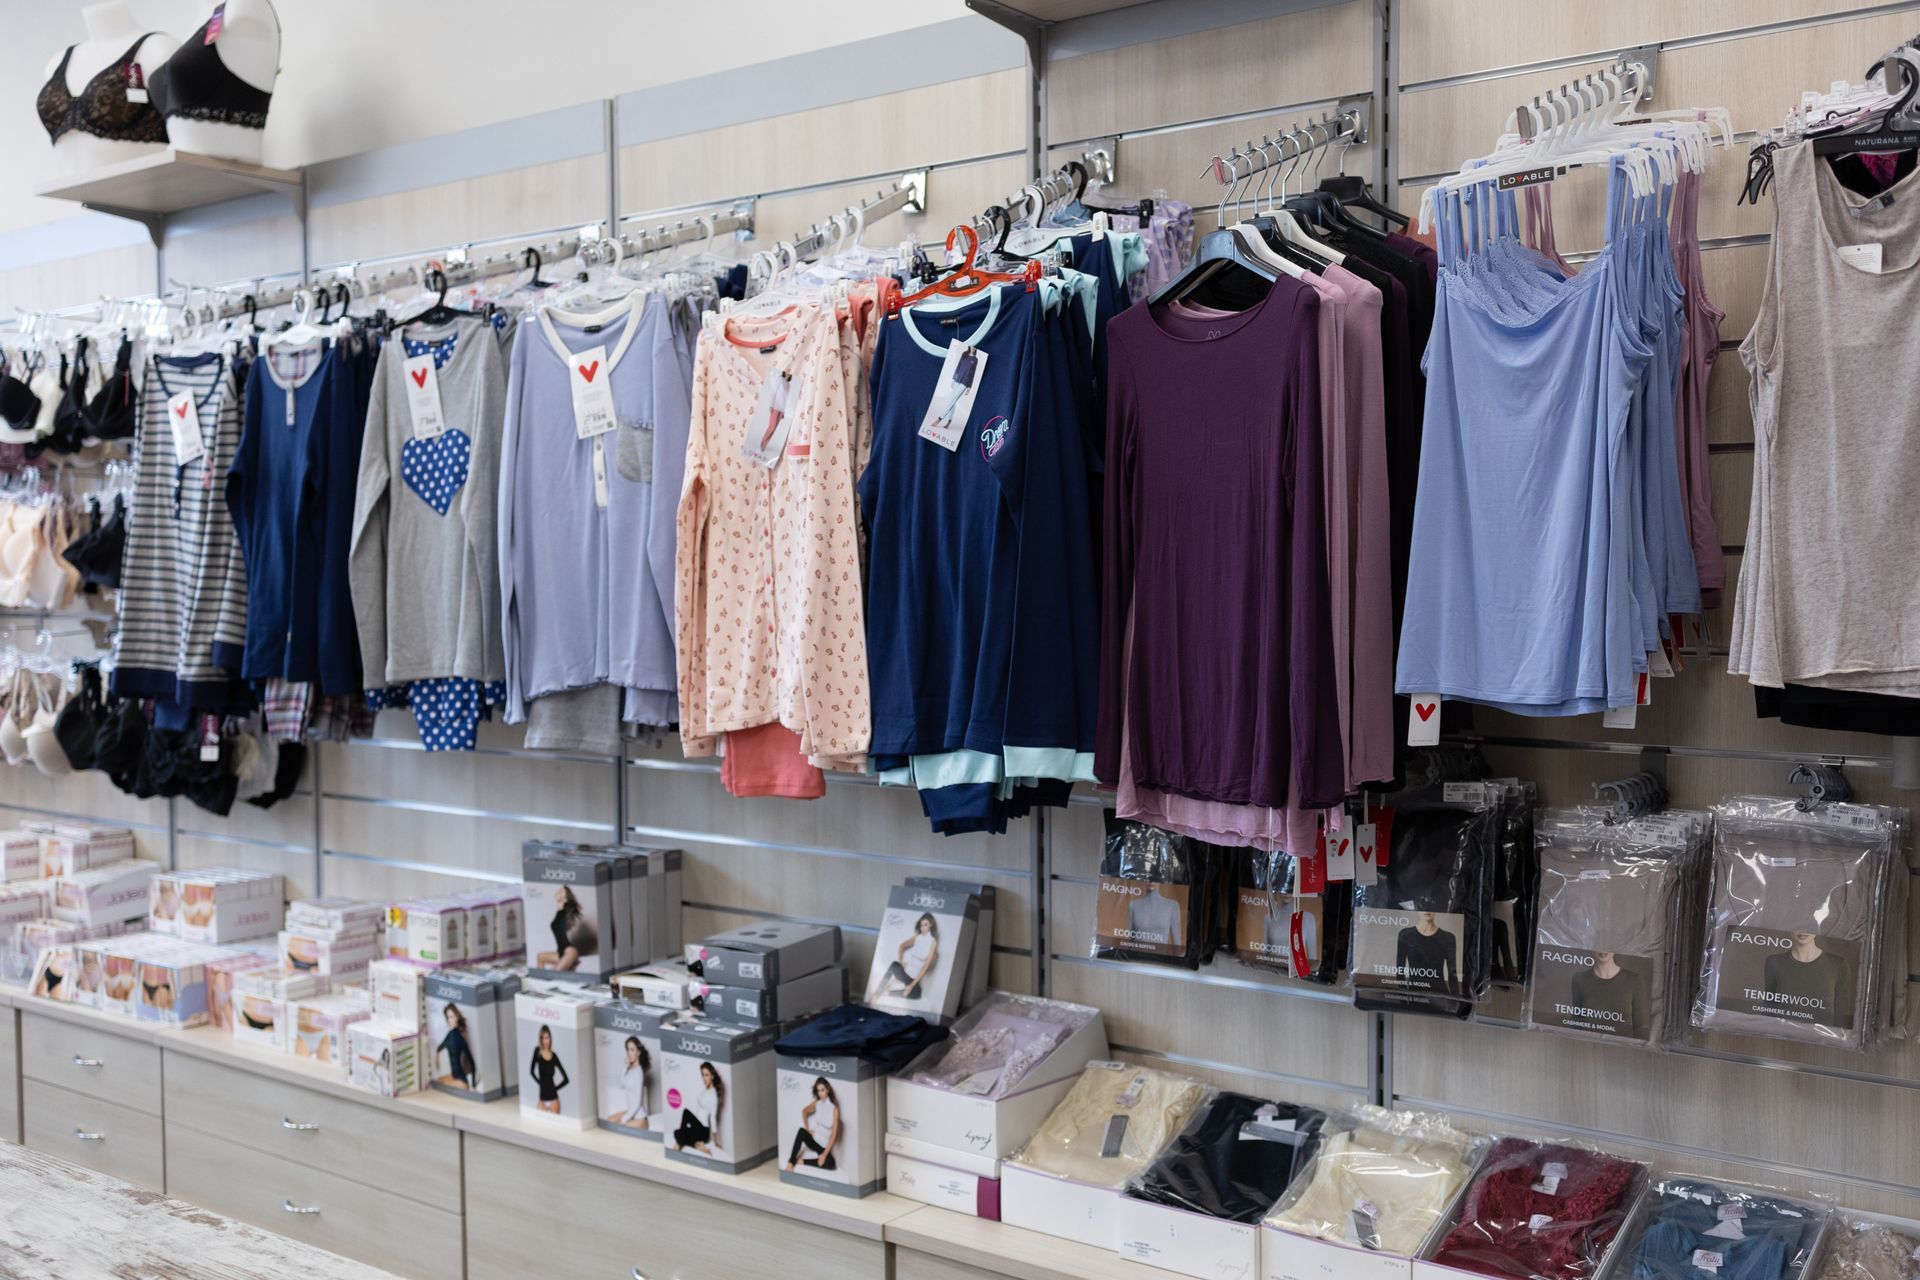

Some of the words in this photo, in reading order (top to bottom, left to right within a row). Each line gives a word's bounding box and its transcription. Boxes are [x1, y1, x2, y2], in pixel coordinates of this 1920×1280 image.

[1855, 137, 1899, 145] NATURANA
[541, 867, 576, 881] Jadea
[1102, 883, 1141, 896] RAGNO
[1241, 895, 1268, 907] RAGN
[1359, 914, 1409, 926] RAGNO
[1113, 928, 1163, 941] ECOCOTTON
[1731, 932, 1793, 949] RAGNO
[1542, 951, 1595, 967] RAGNO
[1373, 964, 1439, 978] TENDERWOOL
[1744, 988, 1826, 1010] TENDERWOOL
[1554, 1003, 1625, 1023] TENDERWOOL
[1752, 1005, 1785, 1015] CASHMERE
[1791, 1011, 1814, 1019] MODAL
[611, 1015, 642, 1031] Jadea
[1562, 1019, 1591, 1028] CASHMERE
[1596, 1024, 1616, 1032] MODAL
[678, 1038, 711, 1055] Jadea
